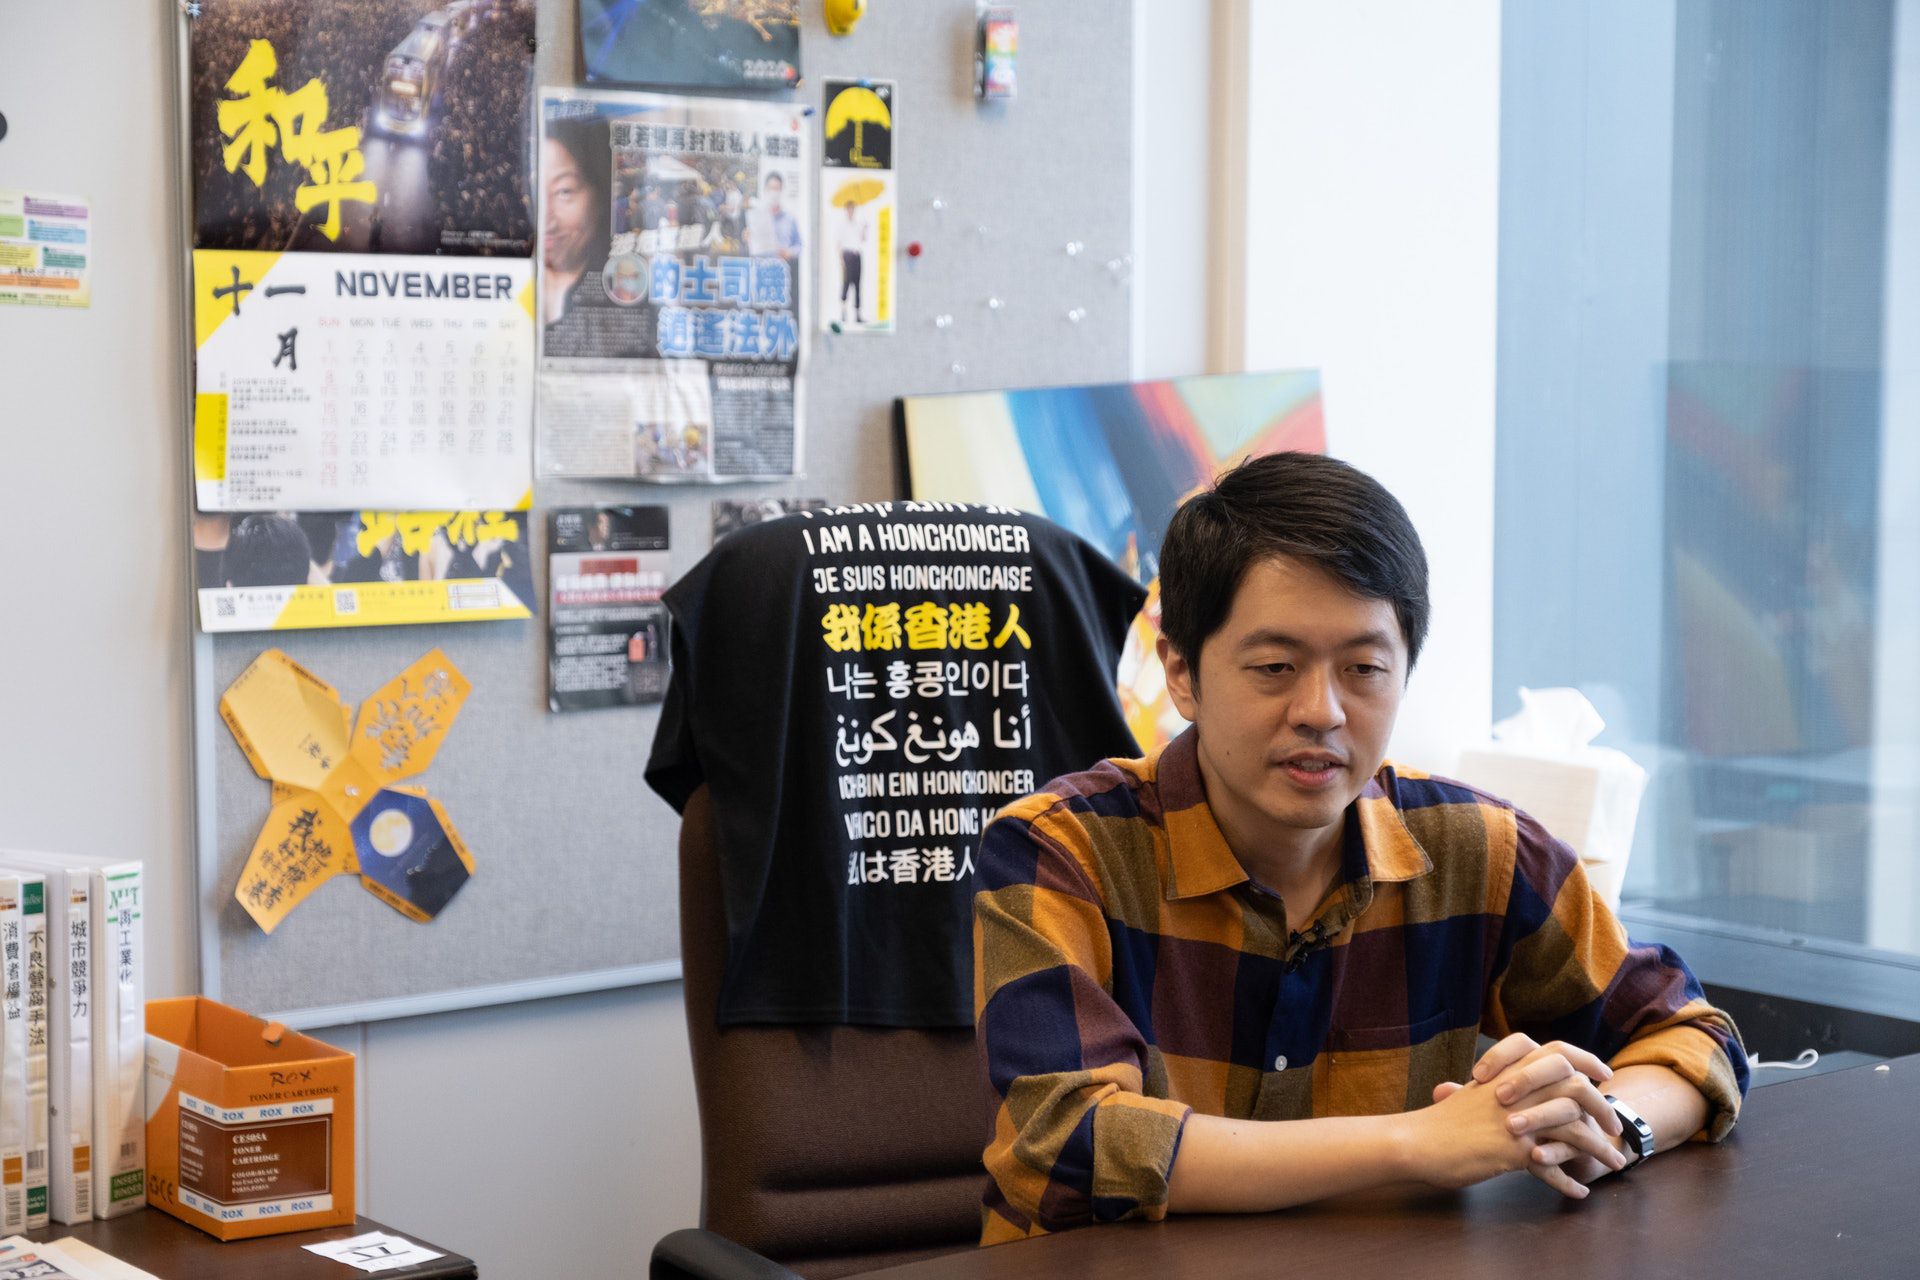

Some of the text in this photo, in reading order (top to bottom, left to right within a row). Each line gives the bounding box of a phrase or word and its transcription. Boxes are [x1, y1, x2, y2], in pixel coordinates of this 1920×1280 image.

[216, 38, 377, 243] 和平
[335, 270, 512, 300] NOVEMBER
[272, 327, 299, 371] 月
[803, 523, 1030, 555] I AM A HONGKONGER
[813, 565, 1032, 593] JE SUIS HONGKONGAISE
[821, 602, 1032, 653] 我係香港人
[826, 659, 1030, 700] 나는 홍콩인이다
[993, 703, 1032, 750] أنا
[889, 771, 919, 797] EIN
[844, 810, 891, 840] VGO
[896, 809, 925, 837] DA
[929, 807, 978, 836] HONG
[70, 920, 87, 1018] 城市競爭力
[222, 1111, 245, 1121] ROX
[260, 1108, 282, 1118] ROX
[292, 1104, 315, 1114] ROX
[221, 1209, 244, 1219] ROX
[259, 1205, 281, 1215] ROX
[291, 1201, 313, 1211] ROX
